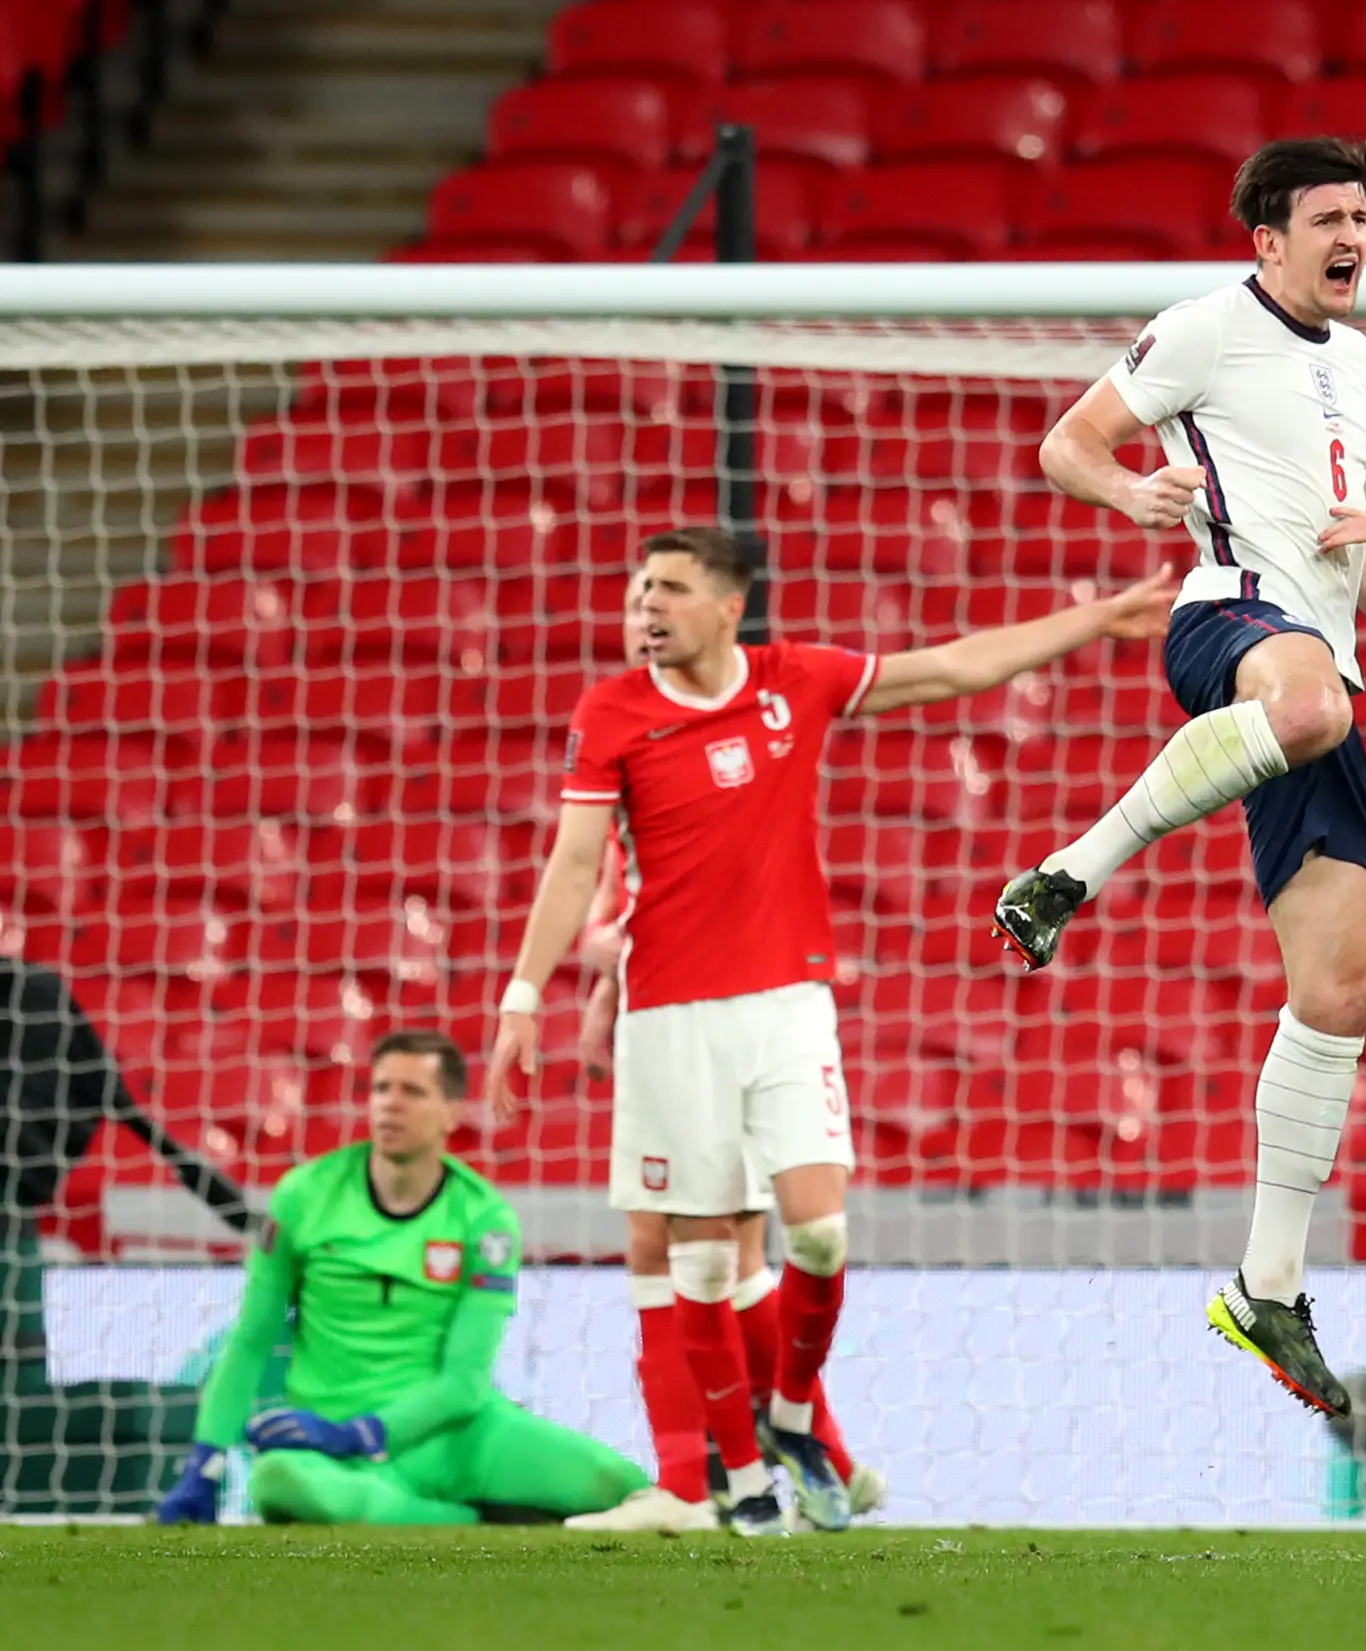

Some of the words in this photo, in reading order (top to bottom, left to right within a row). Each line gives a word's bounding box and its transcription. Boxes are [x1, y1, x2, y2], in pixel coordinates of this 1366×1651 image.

[1330, 439, 1347, 502] 6
[756, 688, 792, 731] 5
[821, 1065, 842, 1116] 5
[1223, 1280, 1257, 1332] PUMA
